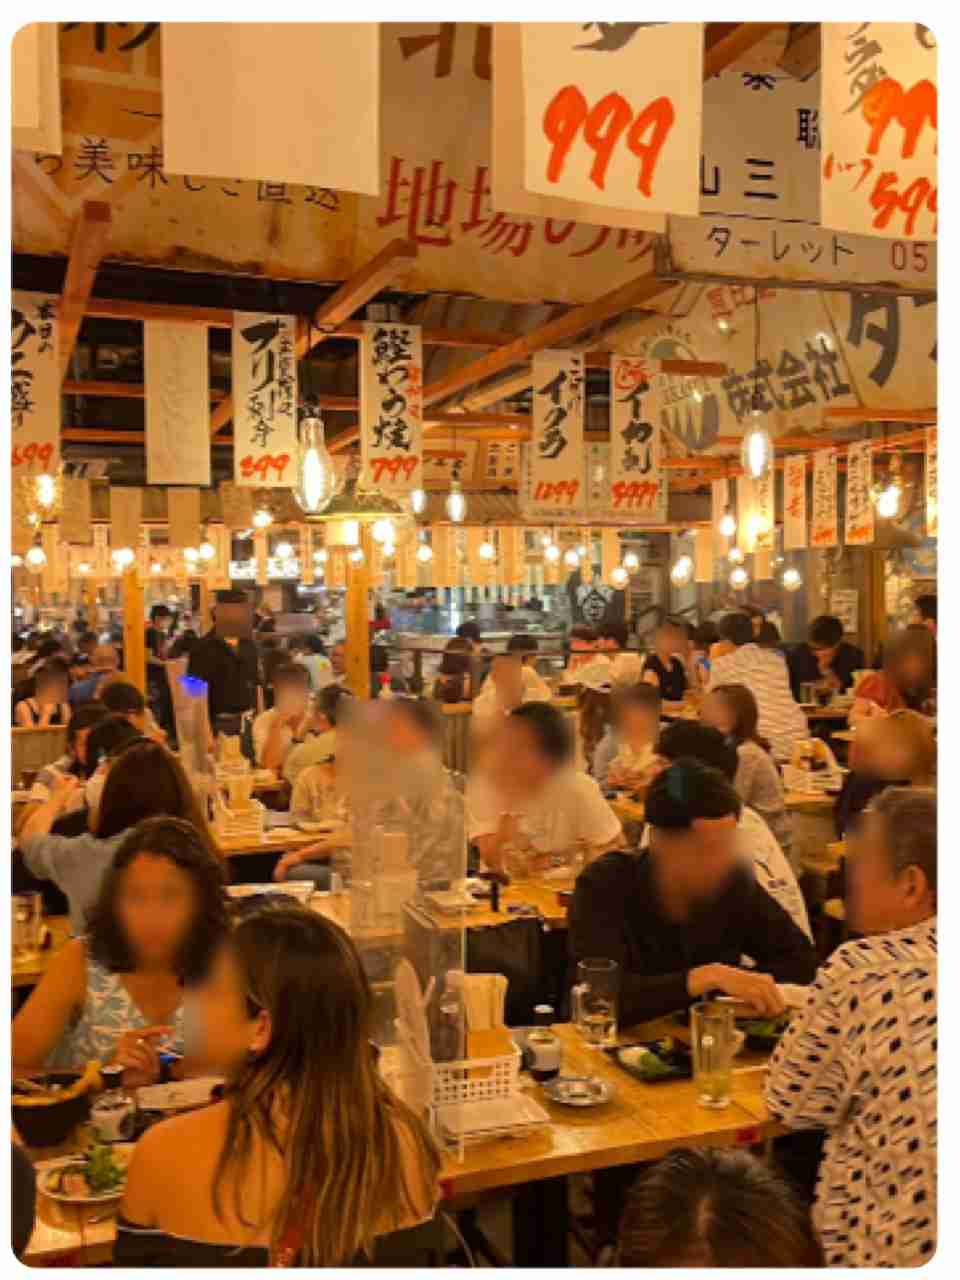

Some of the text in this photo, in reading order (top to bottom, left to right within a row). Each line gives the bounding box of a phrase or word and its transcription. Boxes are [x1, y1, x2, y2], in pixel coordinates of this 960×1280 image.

[542, 84, 676, 199] 999
[707, 227, 929, 273] ターレット 05
[370, 455, 418, 482] 799
